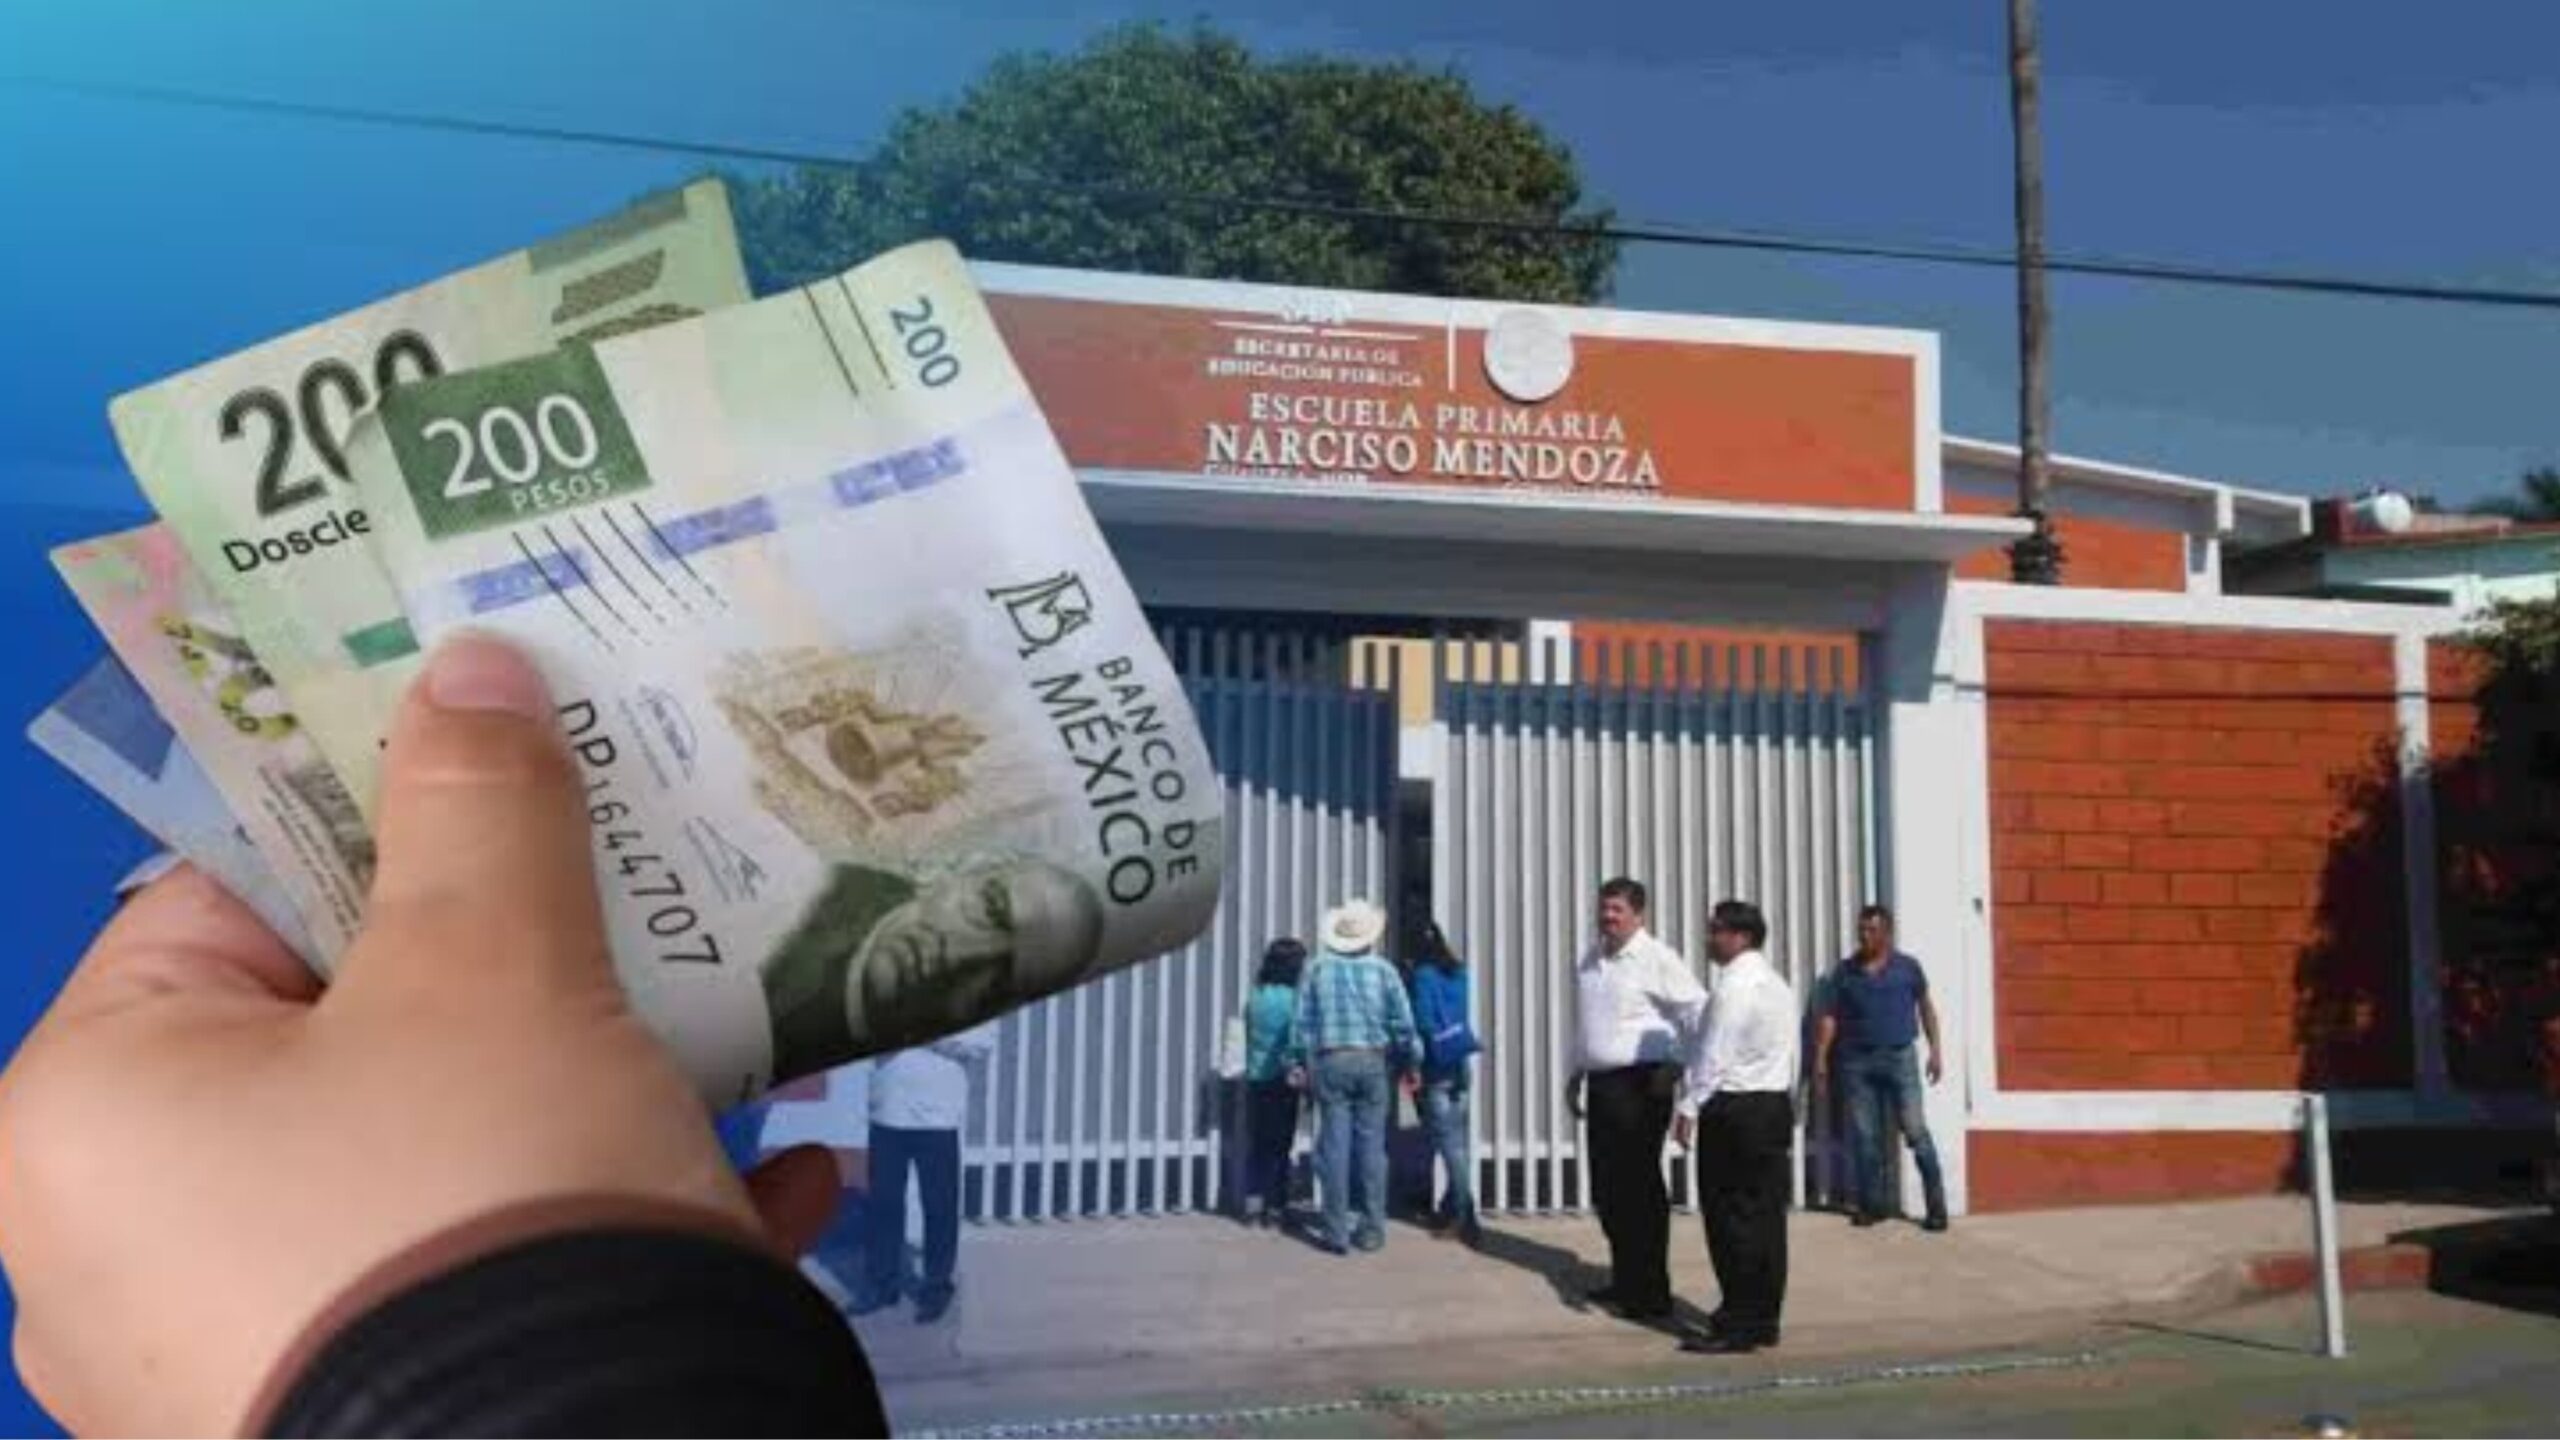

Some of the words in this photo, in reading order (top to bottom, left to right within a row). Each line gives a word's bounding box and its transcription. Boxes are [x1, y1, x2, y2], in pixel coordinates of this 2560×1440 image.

[891, 296, 960, 388] 200
[421, 393, 599, 499] 200
[1206, 421, 1418, 473] NARCISO
[1432, 437, 1661, 488] MENDOZA
[1250, 392, 1421, 429] ESCUELA
[1436, 403, 1625, 442] PRIMARIA
[509, 467, 611, 514] PESOS
[1029, 672, 1155, 906] MÉXICO
[1097, 655, 1186, 802] BANCO
[1162, 819, 1198, 882] DE
